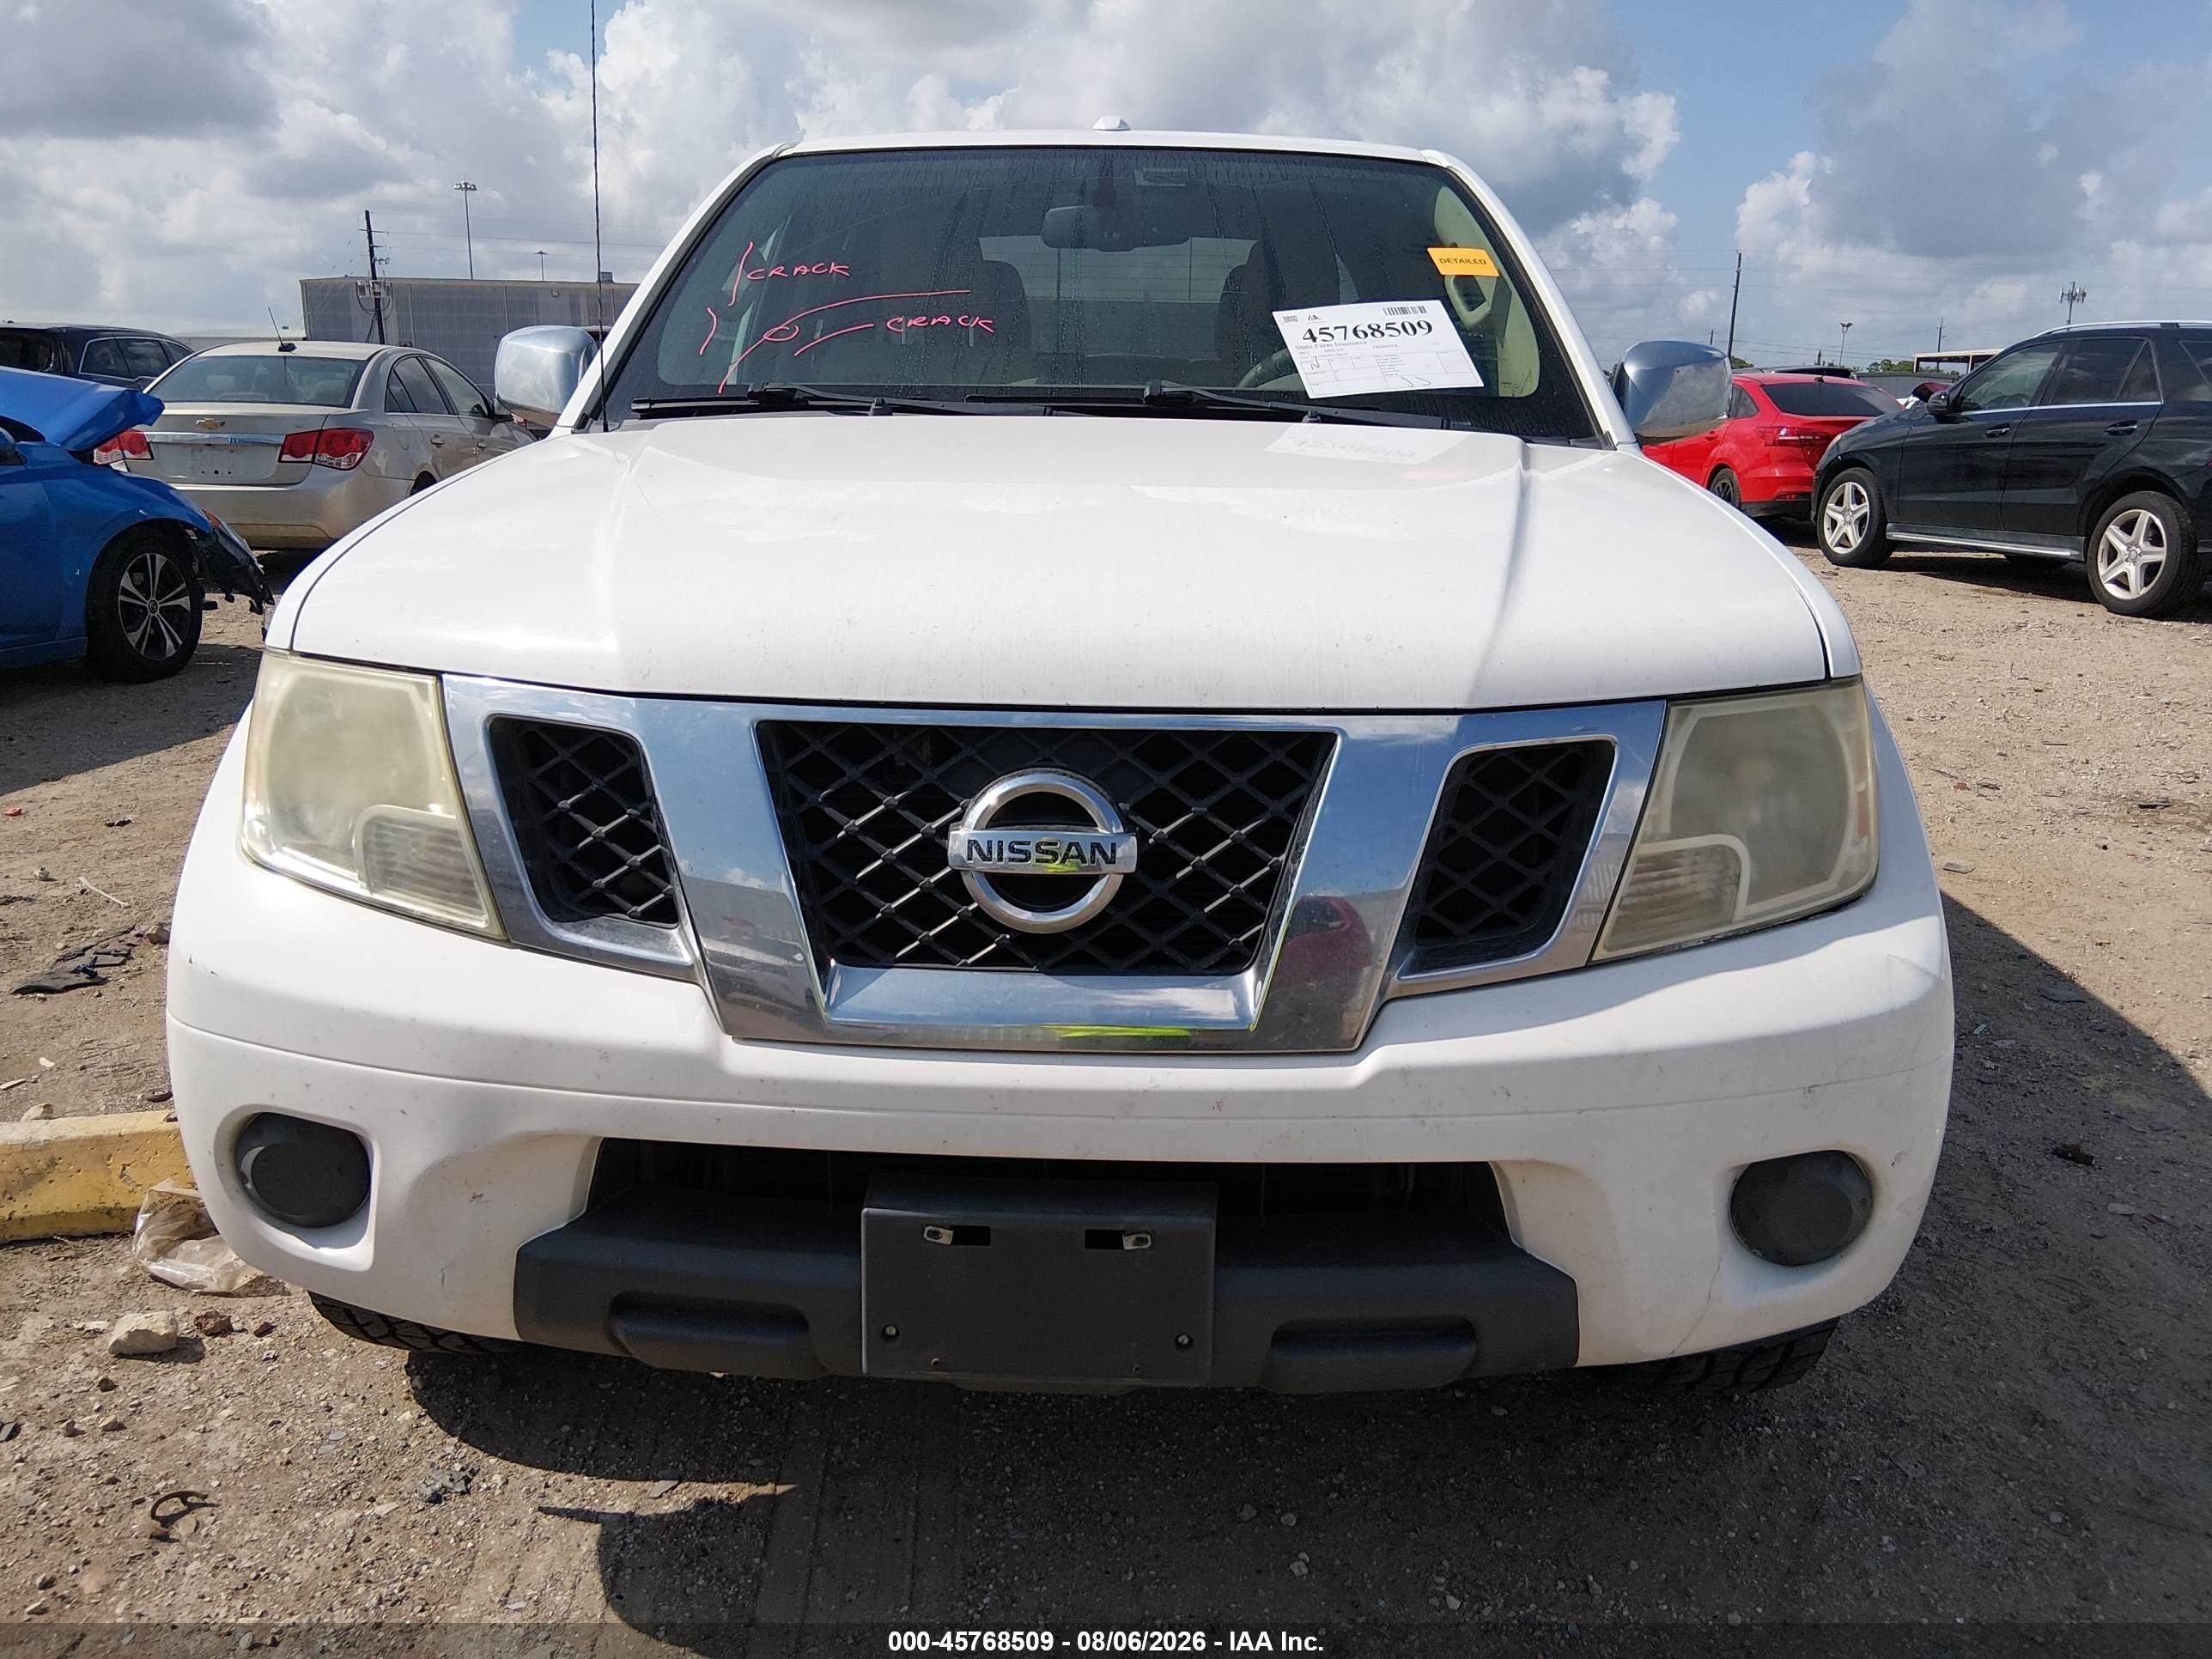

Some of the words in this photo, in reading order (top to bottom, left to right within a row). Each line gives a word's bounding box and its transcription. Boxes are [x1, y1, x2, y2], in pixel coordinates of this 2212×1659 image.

[746, 260, 850, 279] CRACK
[886, 314, 995, 333] CRACK
[1302, 319, 1433, 343] 45768509
[966, 839, 1116, 866] NISSAN
